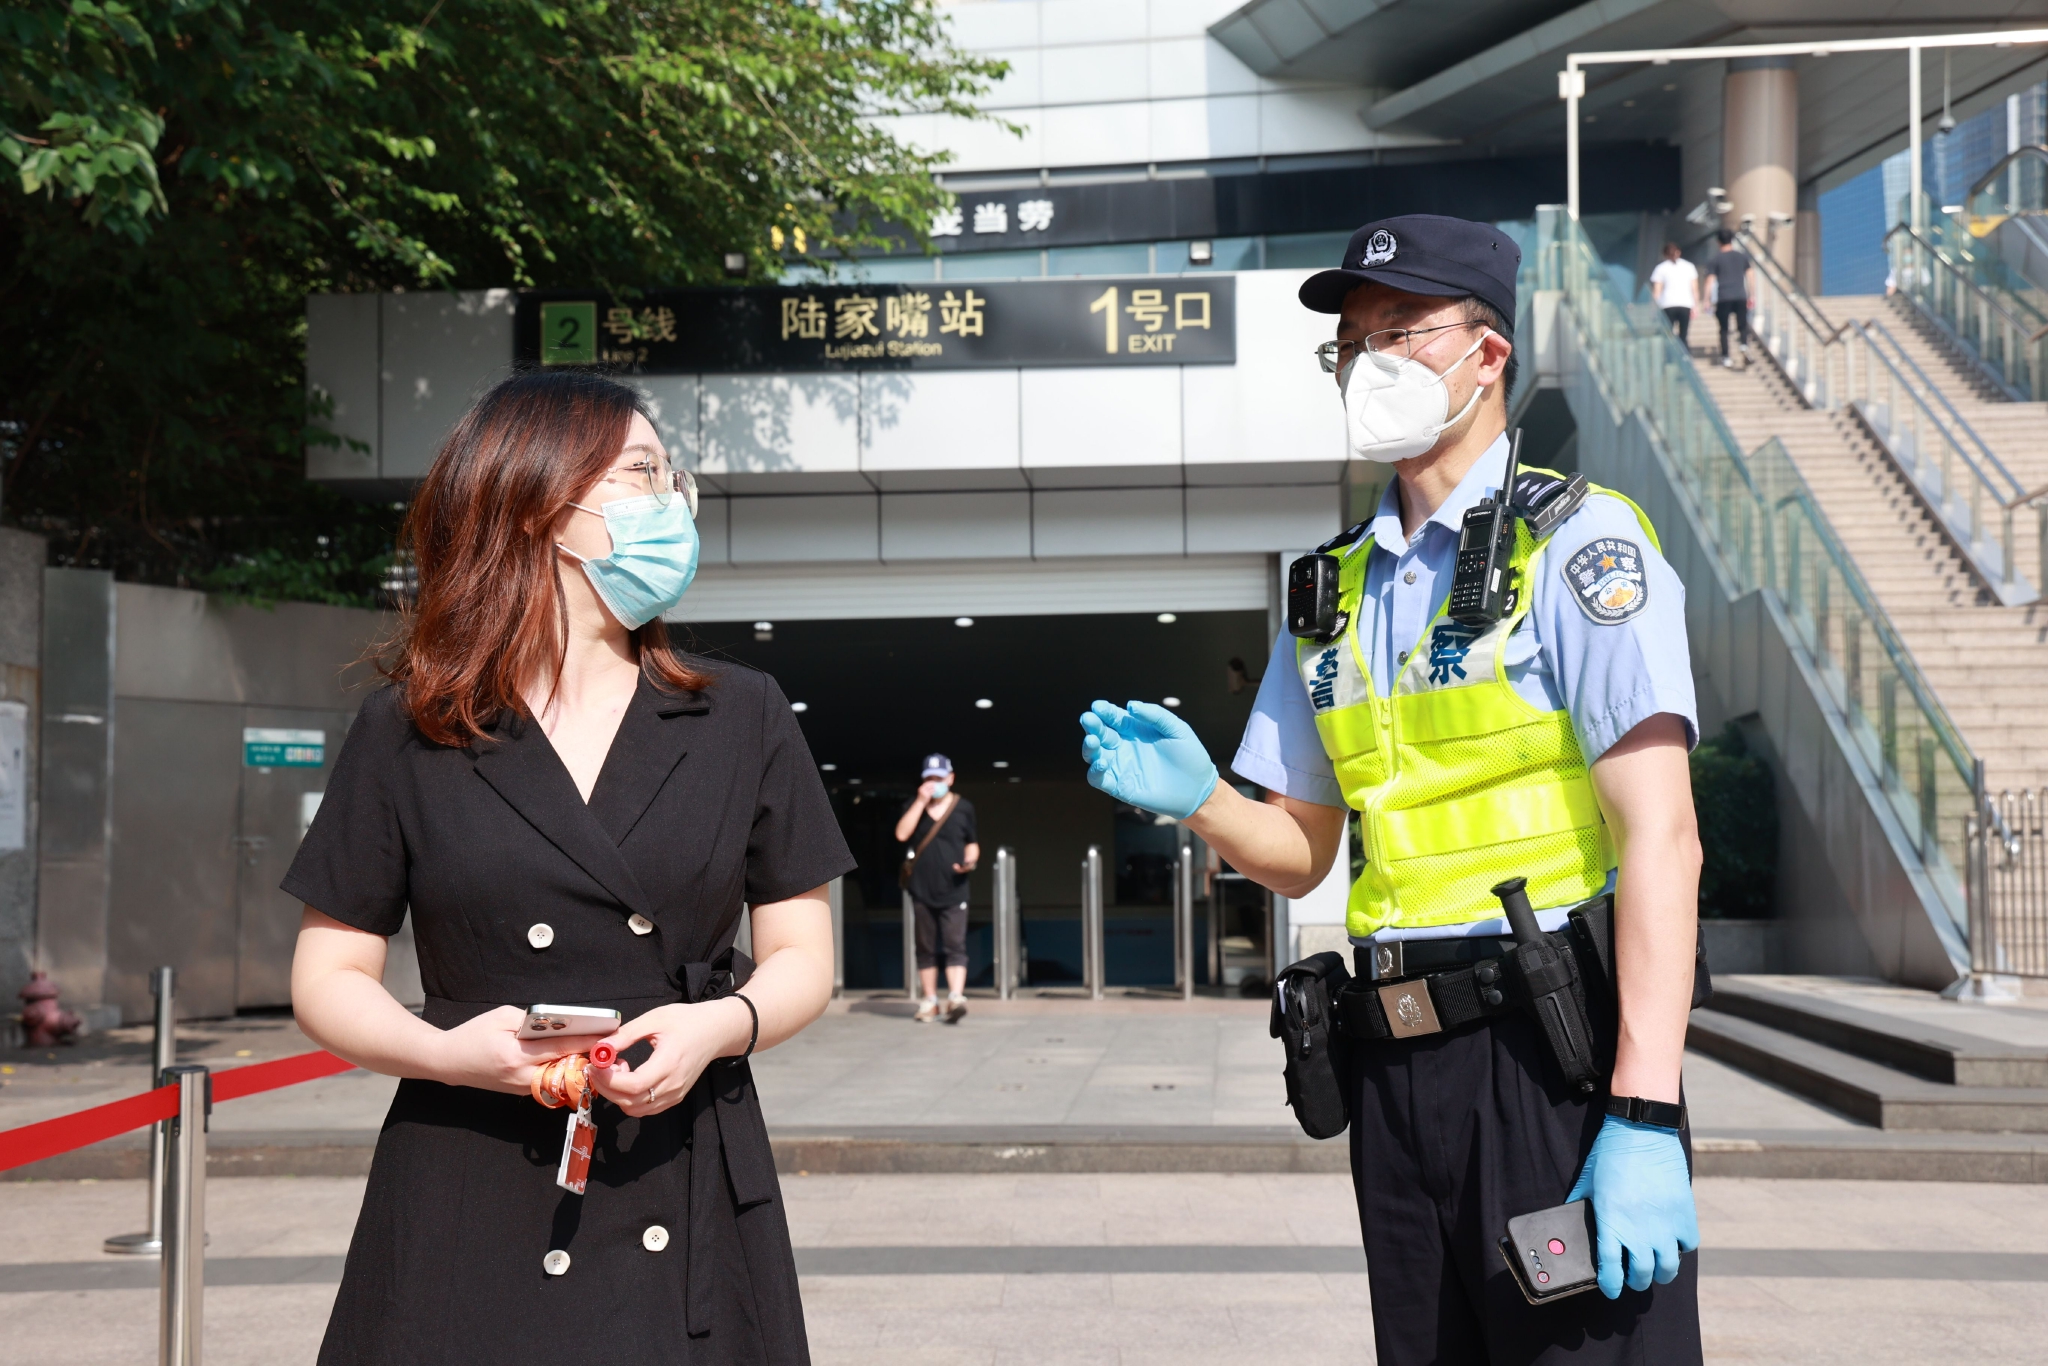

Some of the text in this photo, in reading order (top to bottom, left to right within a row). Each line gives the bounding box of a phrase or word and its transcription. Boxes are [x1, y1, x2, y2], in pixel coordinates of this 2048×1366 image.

[782, 289, 986, 341] 陆家嘴站
[825, 339, 943, 361] Lujiazui Station
[1128, 333, 1177, 354] EXIT
[1569, 540, 1636, 575] 中华人民共和国
